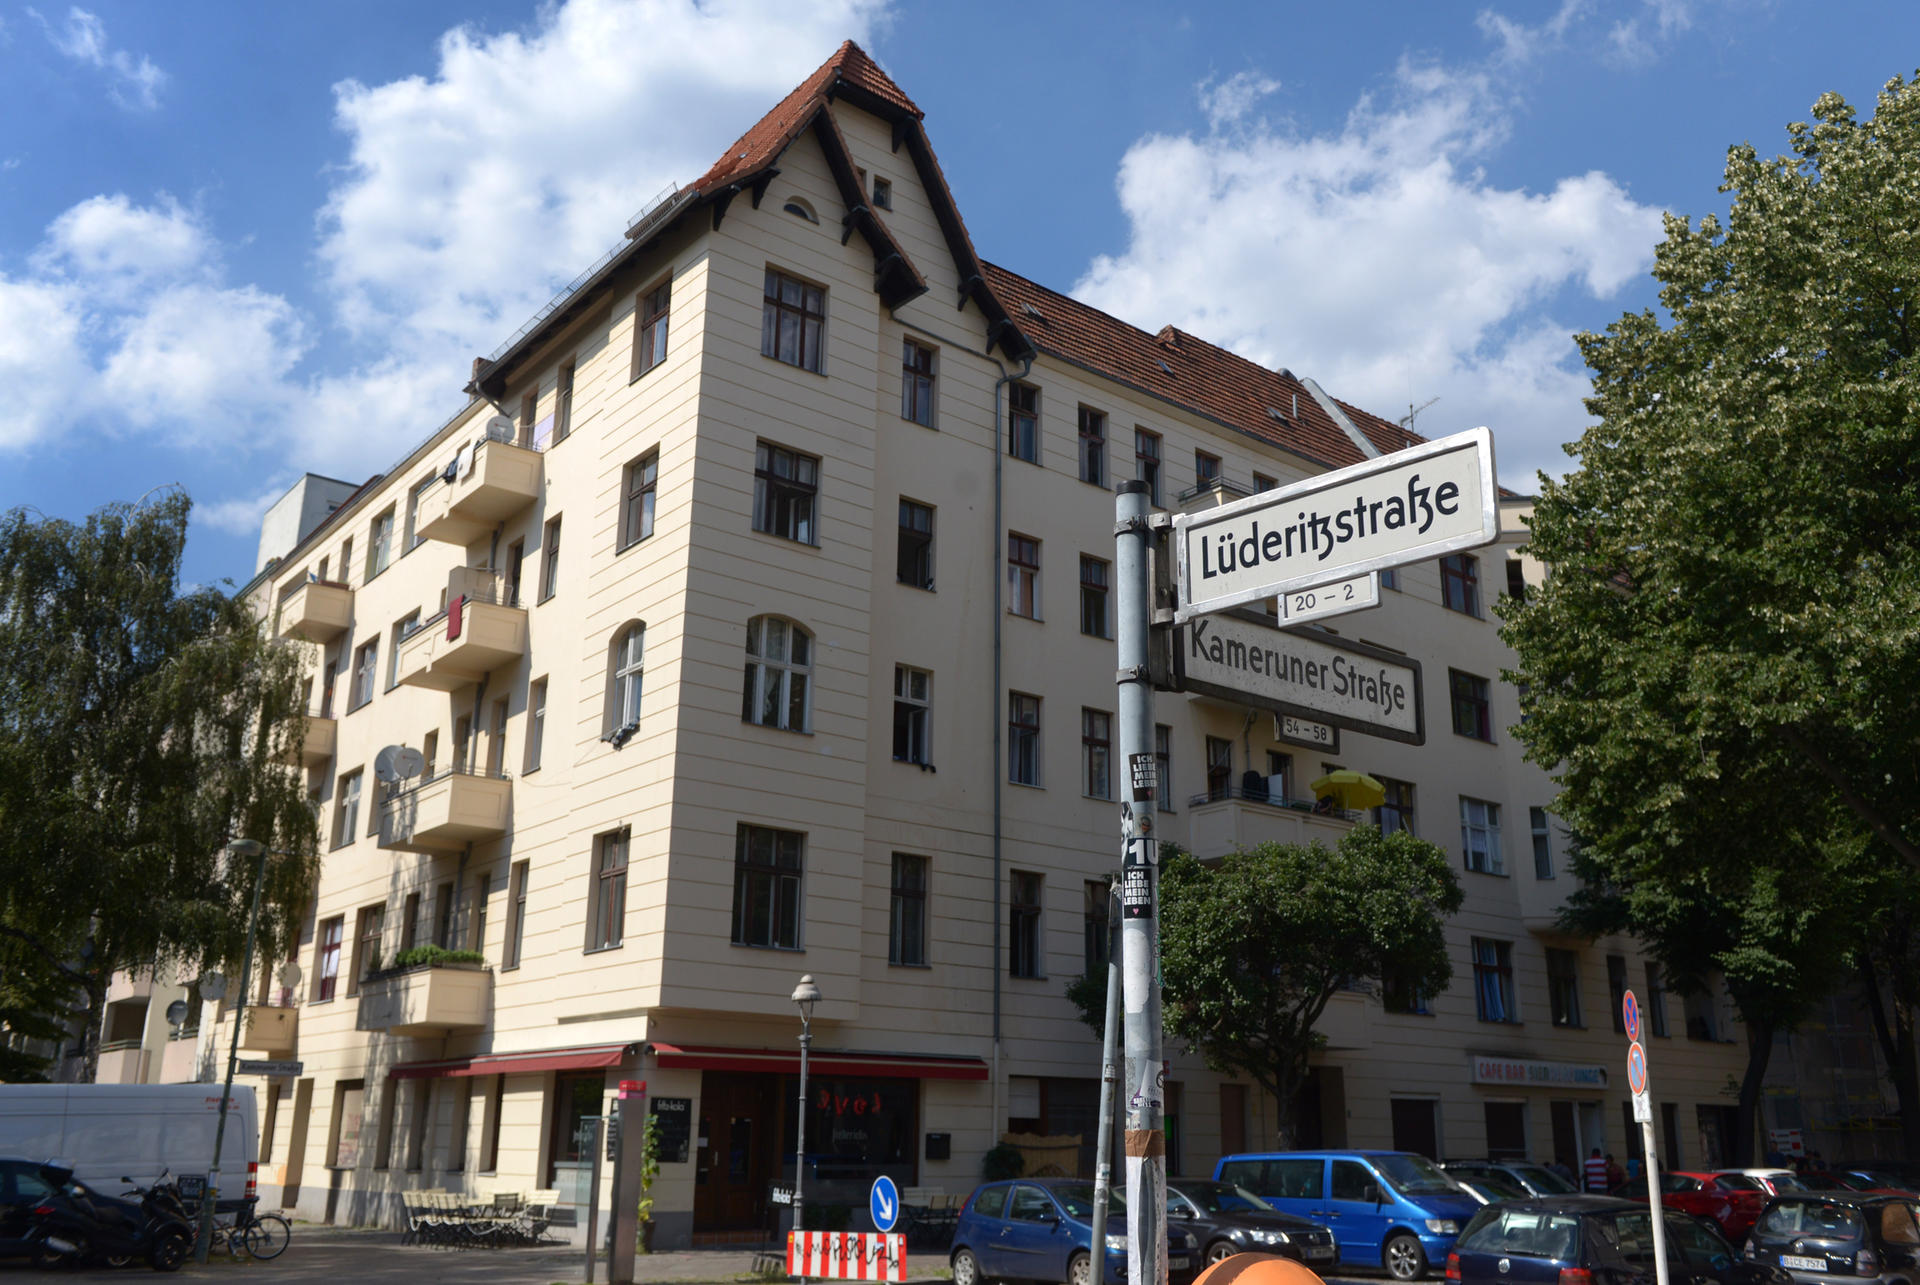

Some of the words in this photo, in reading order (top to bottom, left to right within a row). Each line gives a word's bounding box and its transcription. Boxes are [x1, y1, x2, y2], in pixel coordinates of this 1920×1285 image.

[1201, 474, 1459, 580] Lüderitzstraße
[1295, 593, 1316, 612] 20
[1343, 584, 1354, 601] 2
[1191, 619, 1328, 691] Kameruner
[1332, 656, 1405, 716] Straße
[1286, 719, 1300, 735] 54
[1313, 725, 1327, 741] 58
[1136, 755, 1153, 763] ICH
[1127, 871, 1144, 880] ICH
[1124, 880, 1149, 889] LIEBE
[1124, 888, 1150, 897] MEIN
[1123, 896, 1151, 905] LEBEN
